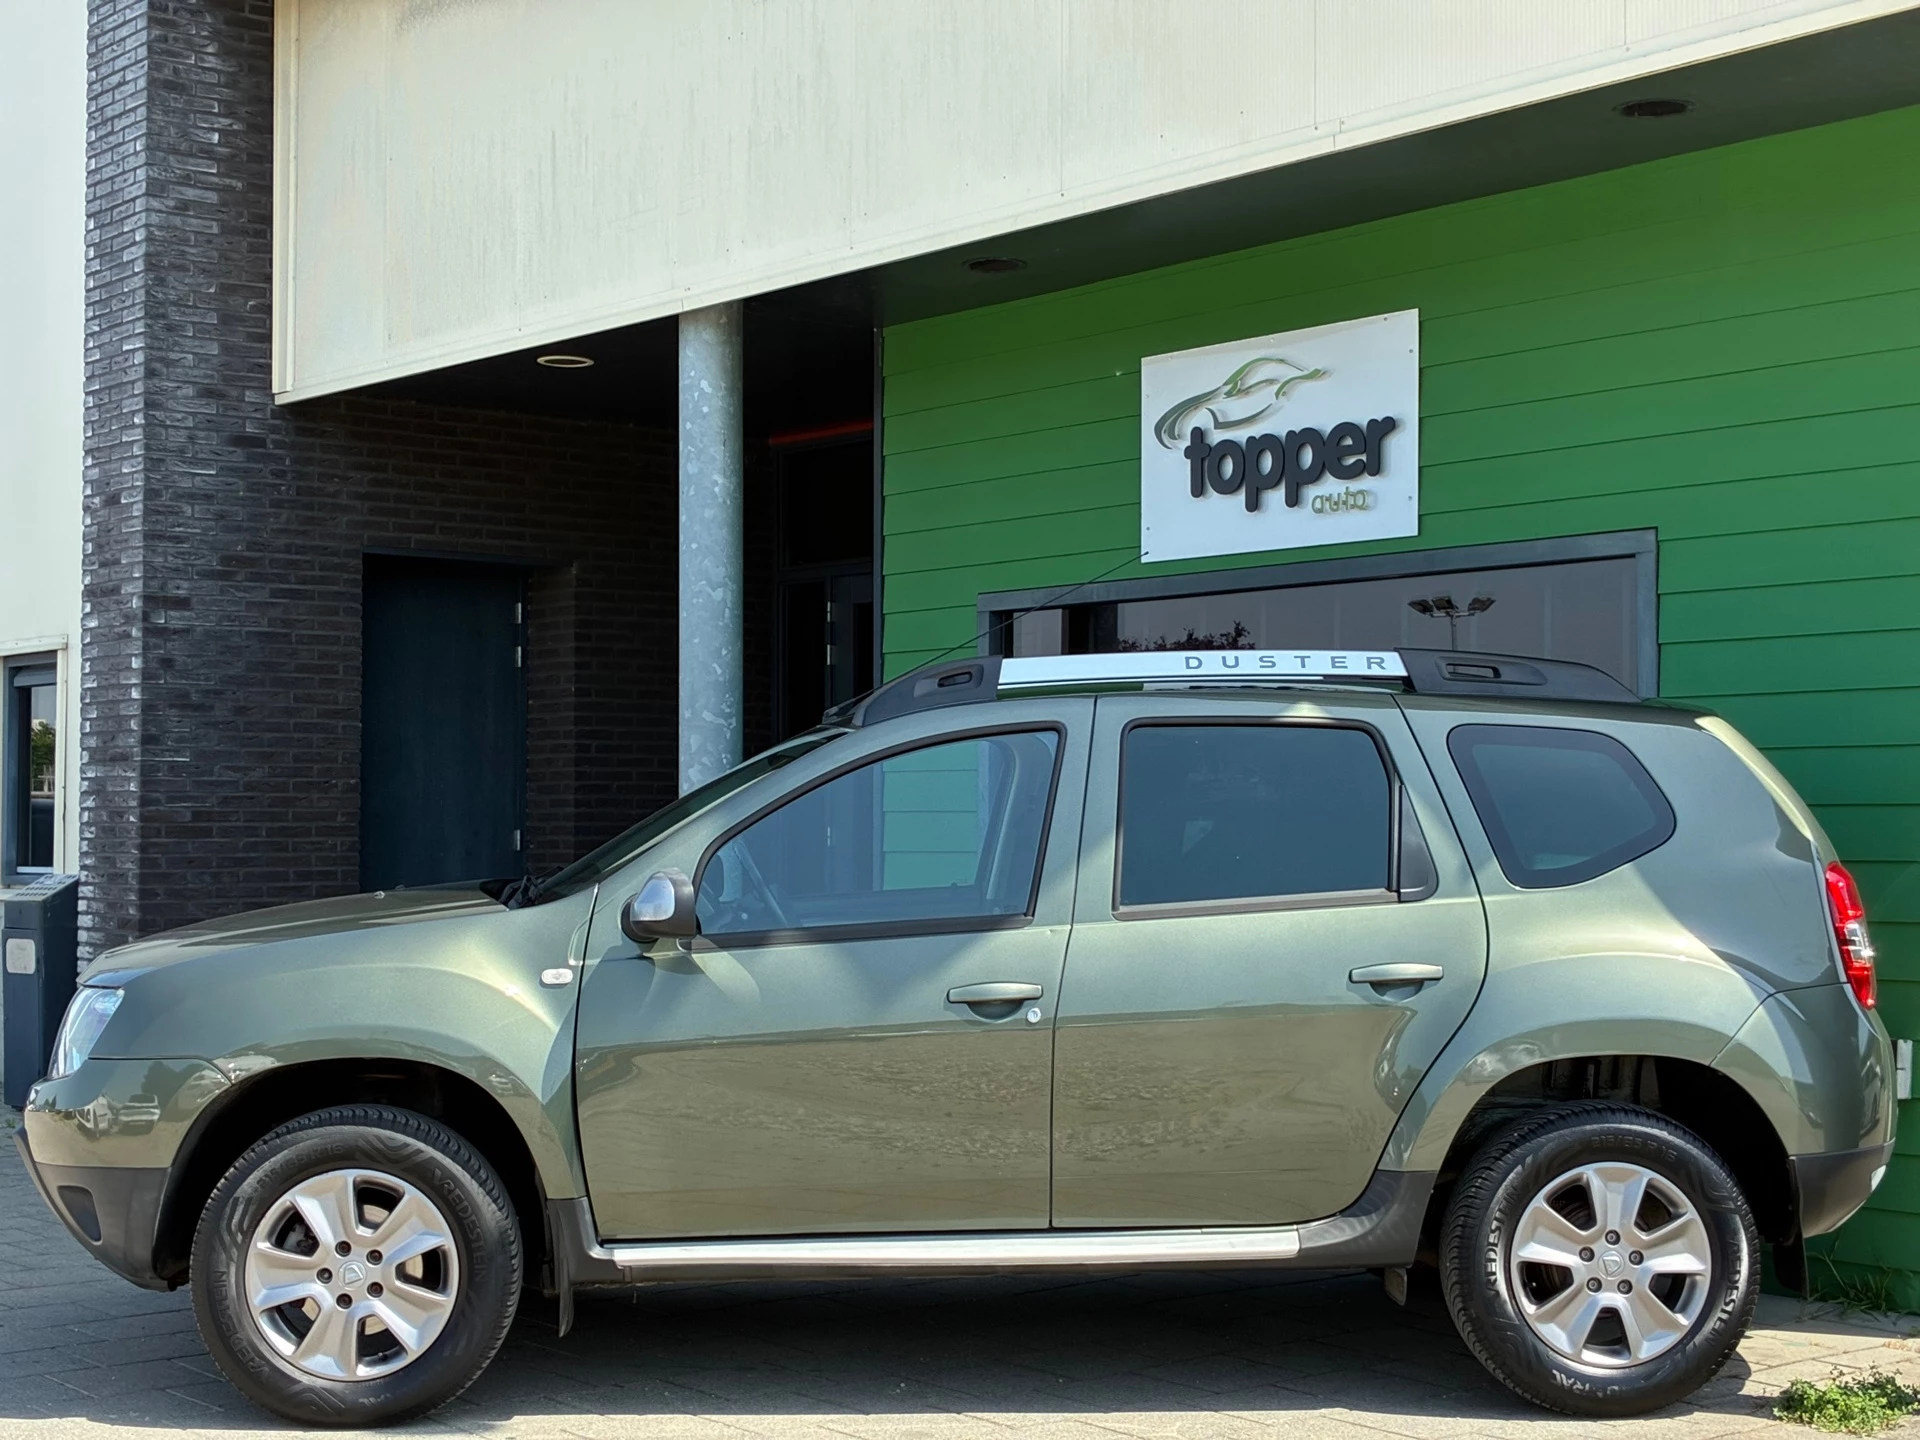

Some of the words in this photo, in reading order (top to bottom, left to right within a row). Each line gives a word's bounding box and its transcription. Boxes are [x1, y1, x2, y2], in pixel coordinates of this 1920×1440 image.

[1184, 416, 1396, 512] topper
[1311, 486, 1369, 514] auto
[1185, 656, 1386, 670] DUSTER
[430, 1167, 487, 1283] VREDESTEIN
[212, 1270, 271, 1384] VREDESTEIN
